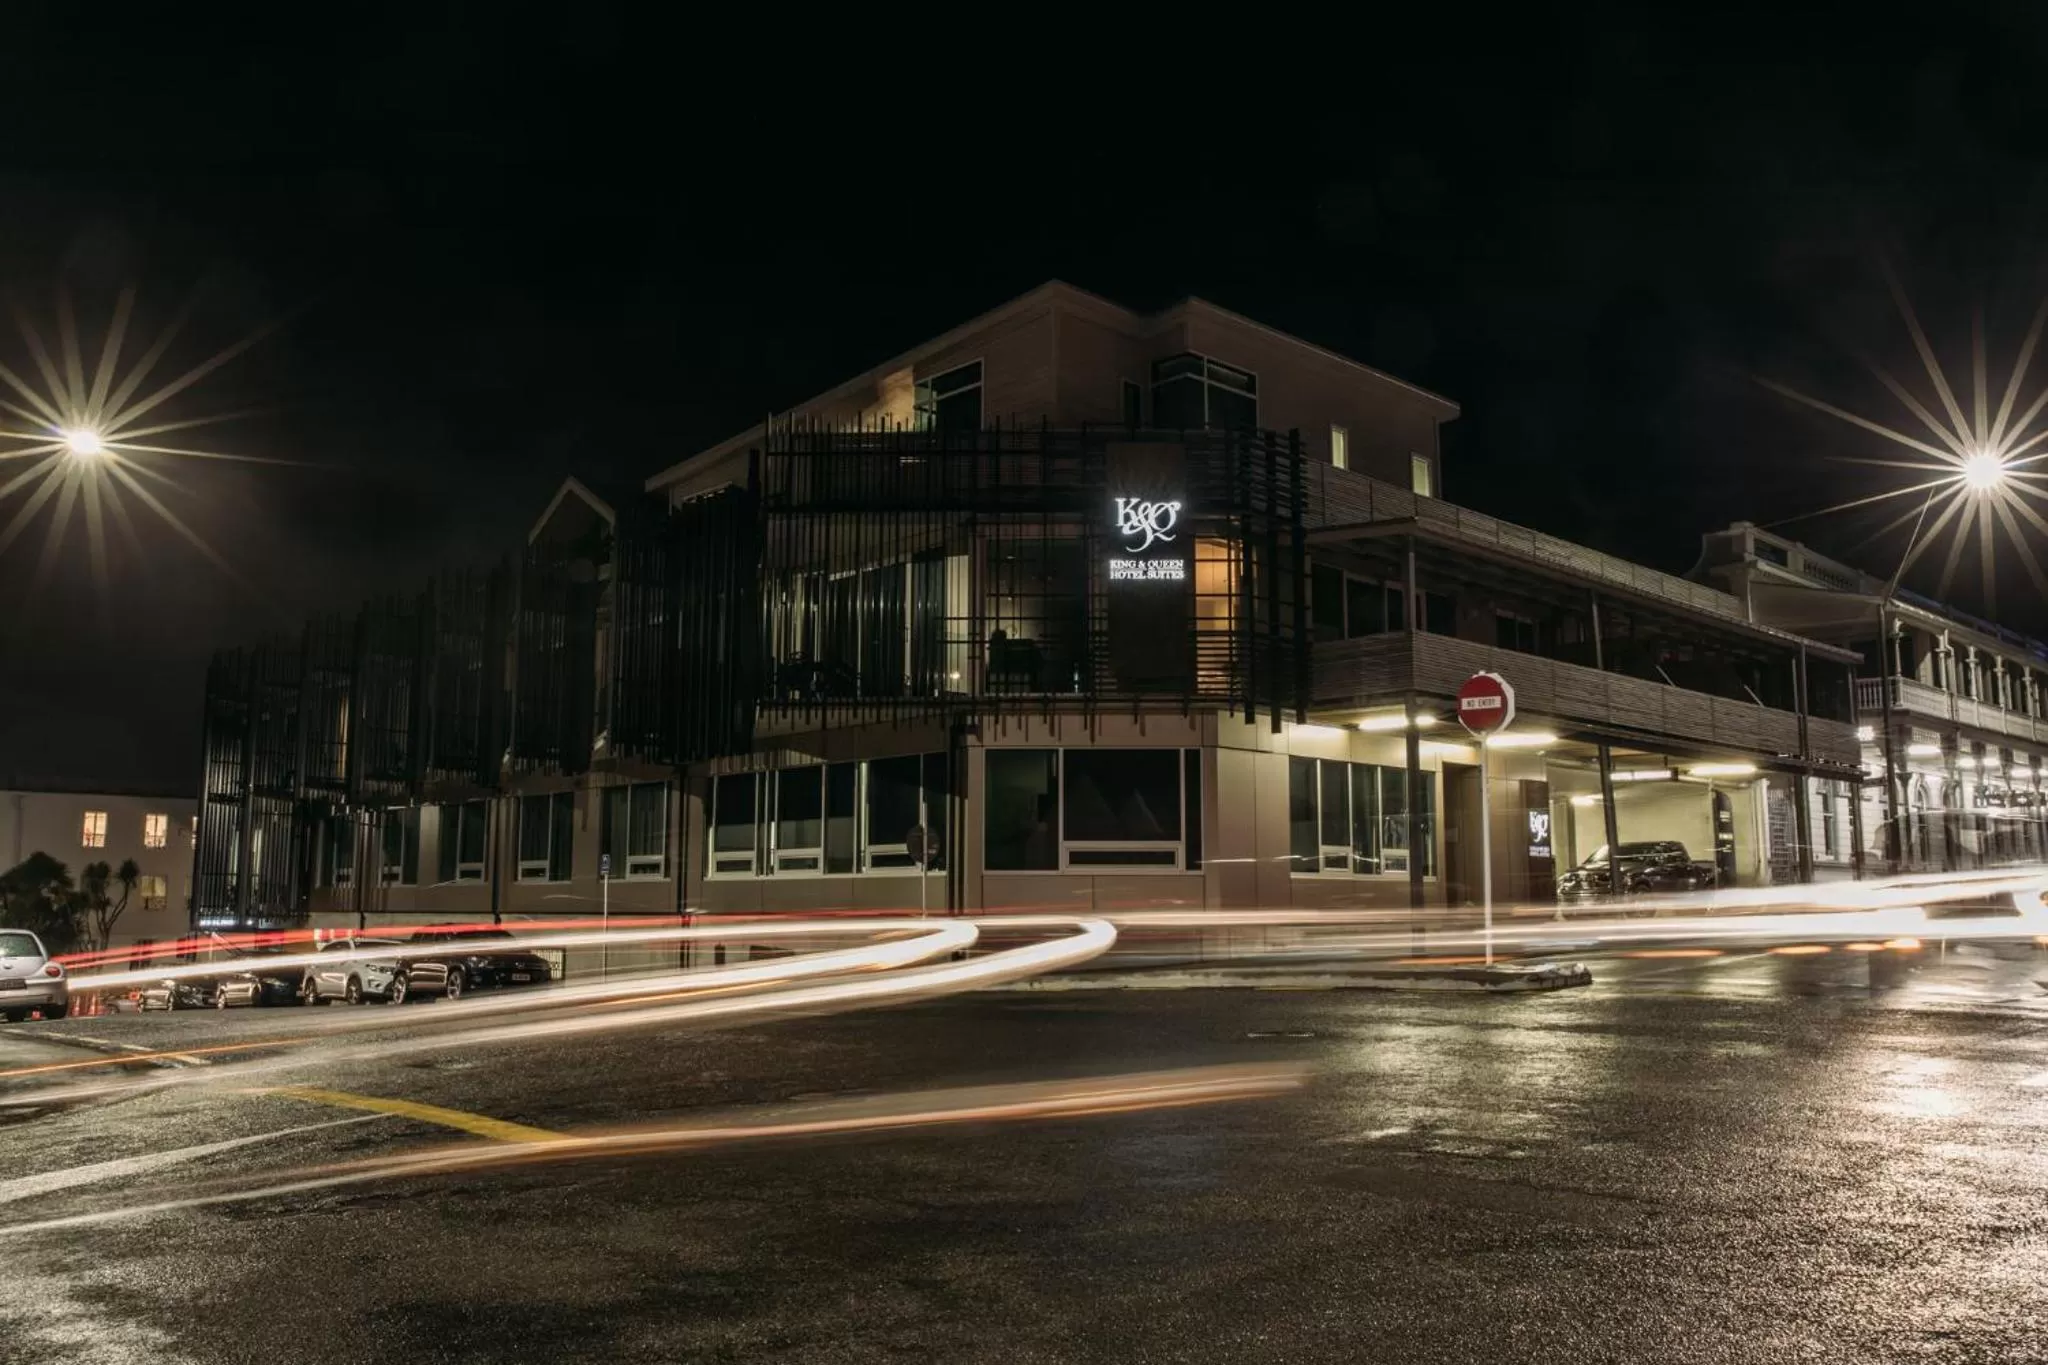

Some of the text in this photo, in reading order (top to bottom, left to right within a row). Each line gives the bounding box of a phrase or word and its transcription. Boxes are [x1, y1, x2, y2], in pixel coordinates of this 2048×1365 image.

[1109, 559, 1184, 570] KING & QUEEN
[1109, 570, 1185, 580] HOTEL SUITES
